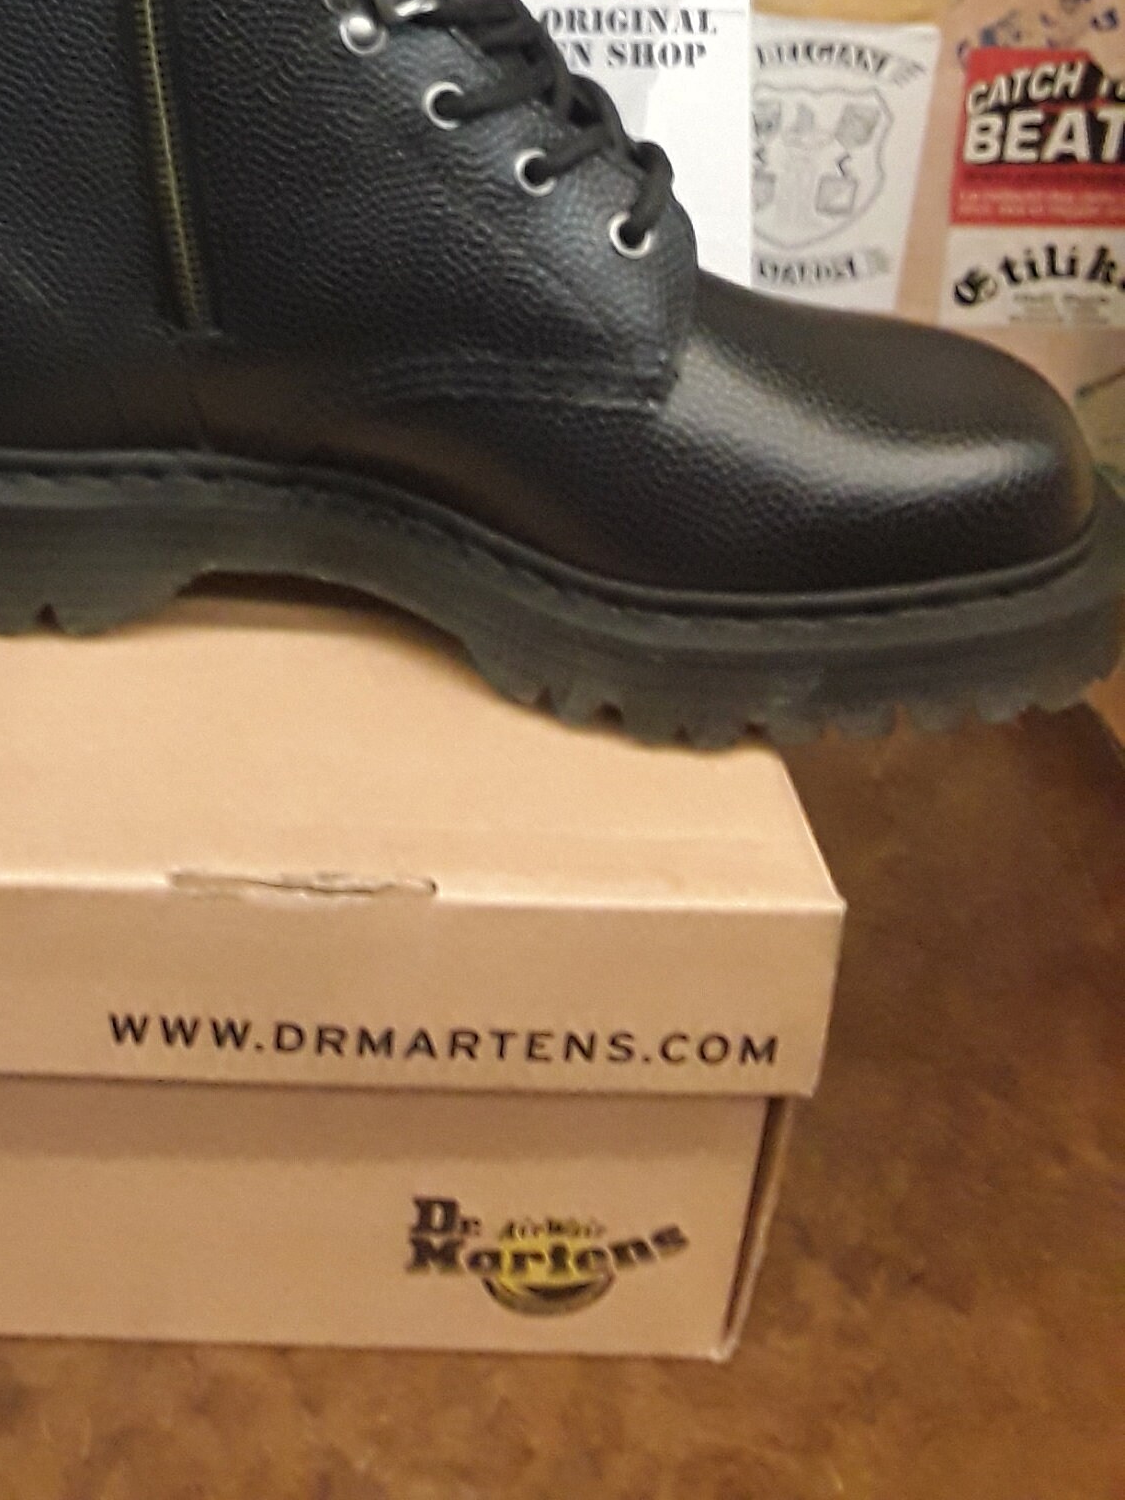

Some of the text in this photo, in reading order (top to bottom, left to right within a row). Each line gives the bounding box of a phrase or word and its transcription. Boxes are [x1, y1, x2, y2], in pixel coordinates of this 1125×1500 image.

[542, 7, 717, 36] ORIGINAL
[607, 42, 708, 69] SHOP
[968, 60, 1088, 116] CATCH
[963, 107, 1125, 164] BEAT
[109, 1011, 780, 1067] WWW.DRMARTENS.COM
[407, 1224, 690, 1276] Martens
